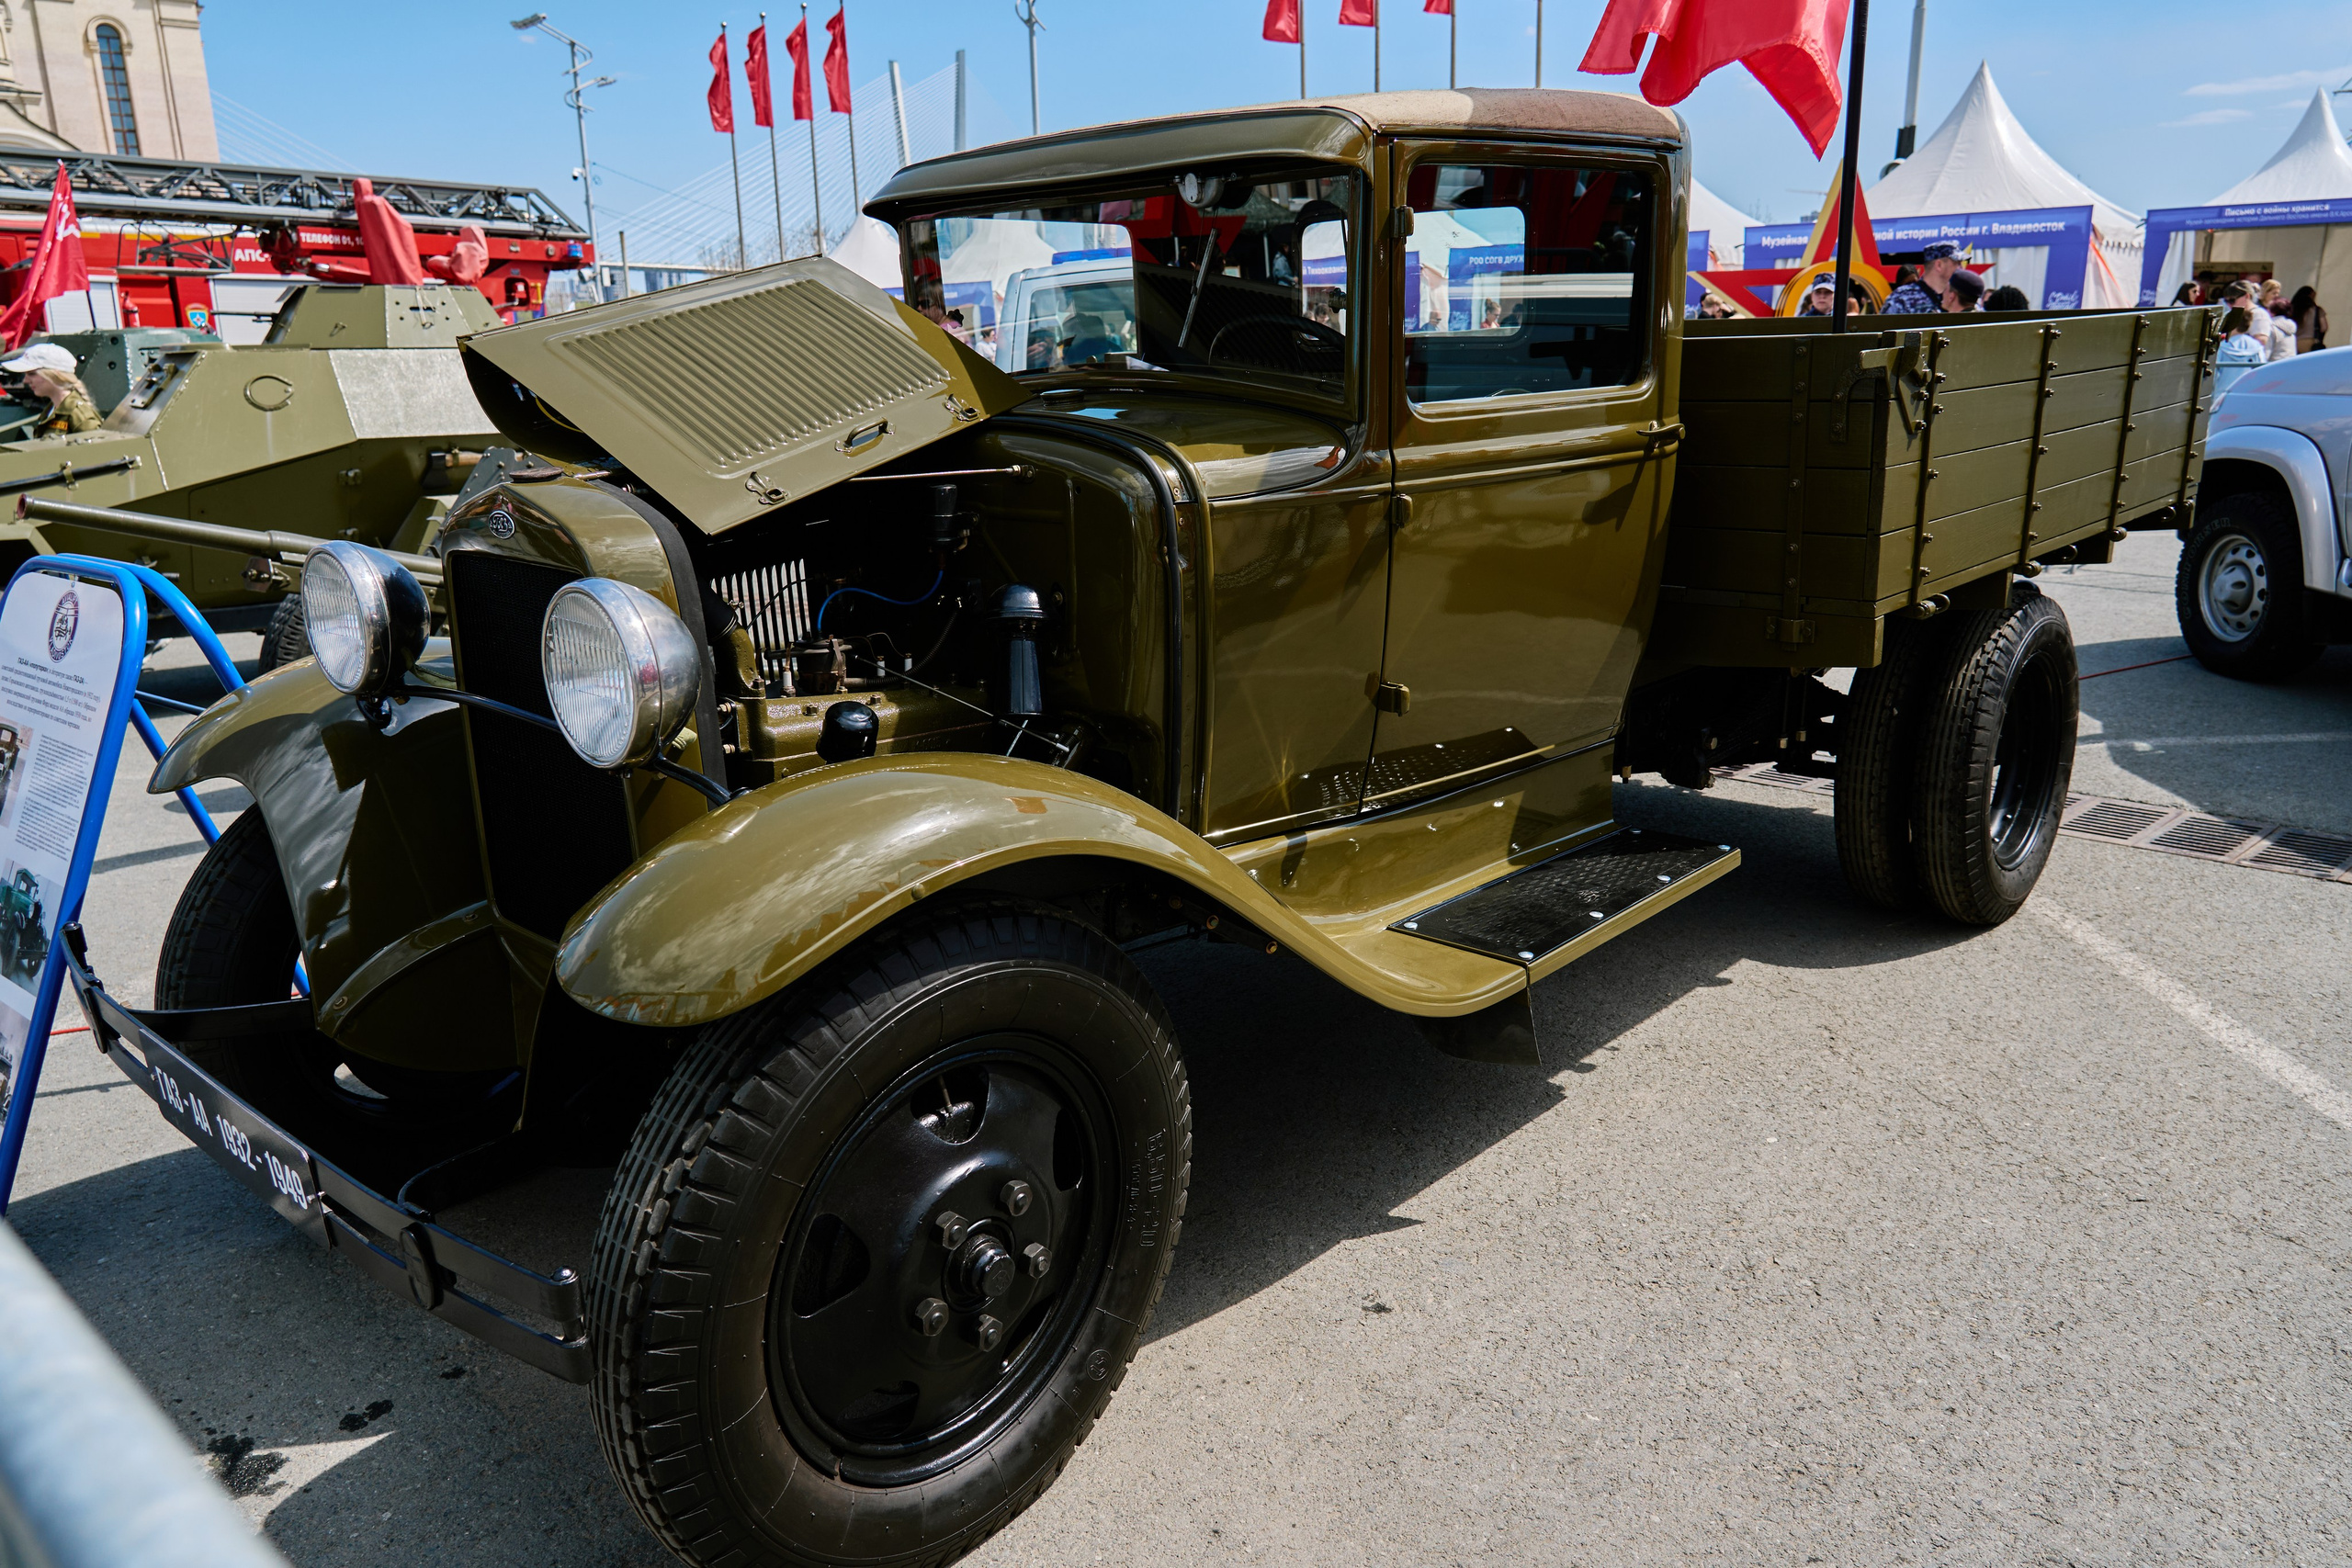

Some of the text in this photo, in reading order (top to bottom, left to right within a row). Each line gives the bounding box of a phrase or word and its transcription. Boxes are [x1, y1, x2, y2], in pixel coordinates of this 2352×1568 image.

[2224, 208, 2256, 217] Письмо
[2263, 205, 2290, 214] войны
[2291, 204, 2330, 213] хранится
[300, 231, 341, 244] ТЕЛЕФОН
[1761, 234, 1809, 249] Музейная
[1872, 229, 1894, 241] ной
[1895, 229, 1938, 241] истории
[1940, 226, 1979, 237] России
[1992, 221, 2065, 235] Владивосток
[234, 249, 272, 262] АПС-
[1469, 256, 1484, 265] РОО
